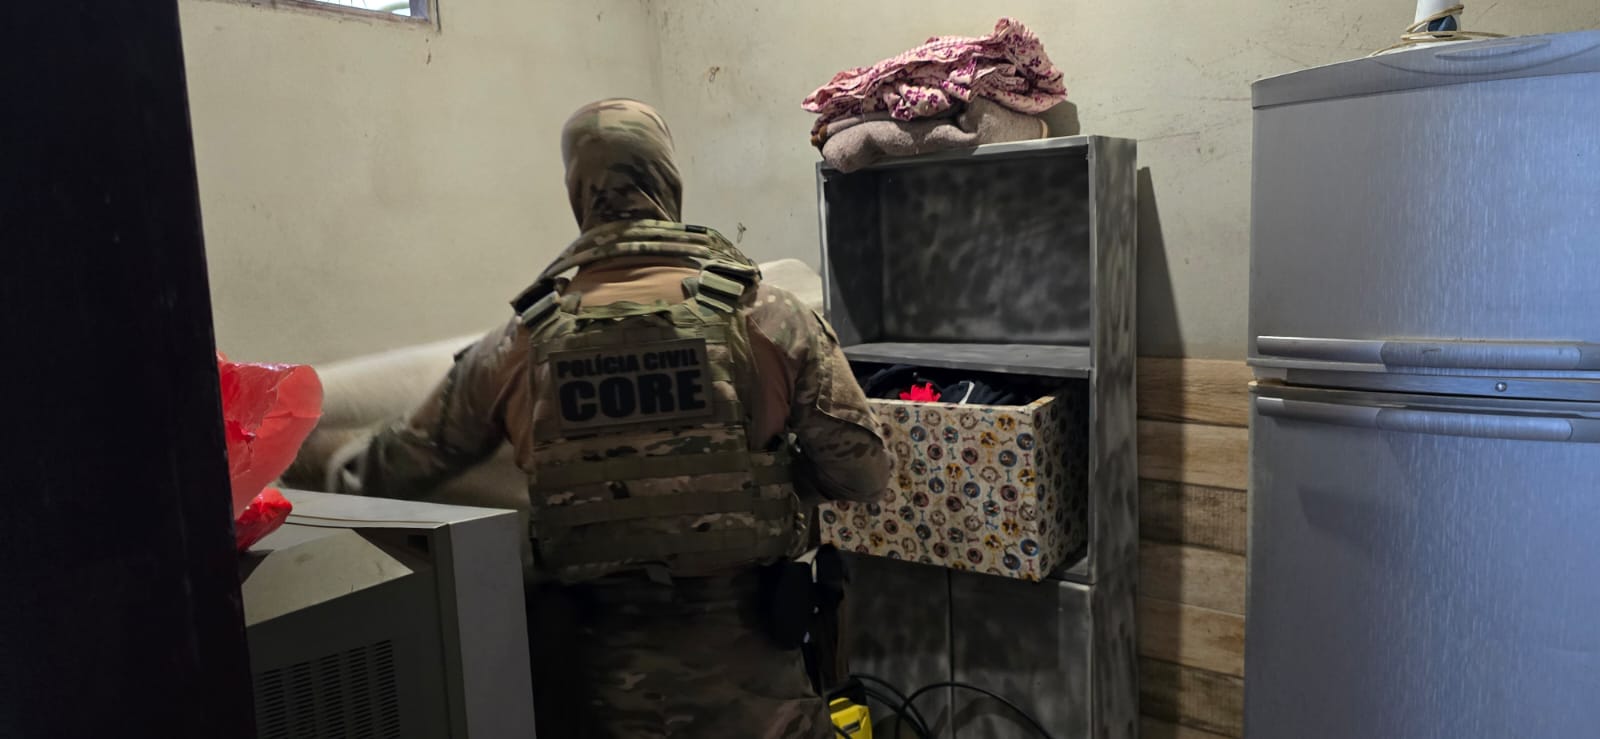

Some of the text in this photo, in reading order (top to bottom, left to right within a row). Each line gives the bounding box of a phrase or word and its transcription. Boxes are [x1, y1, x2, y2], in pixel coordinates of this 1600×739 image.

[557, 348, 699, 378] POLÍCIA CIVIL
[559, 369, 706, 422] CORE
